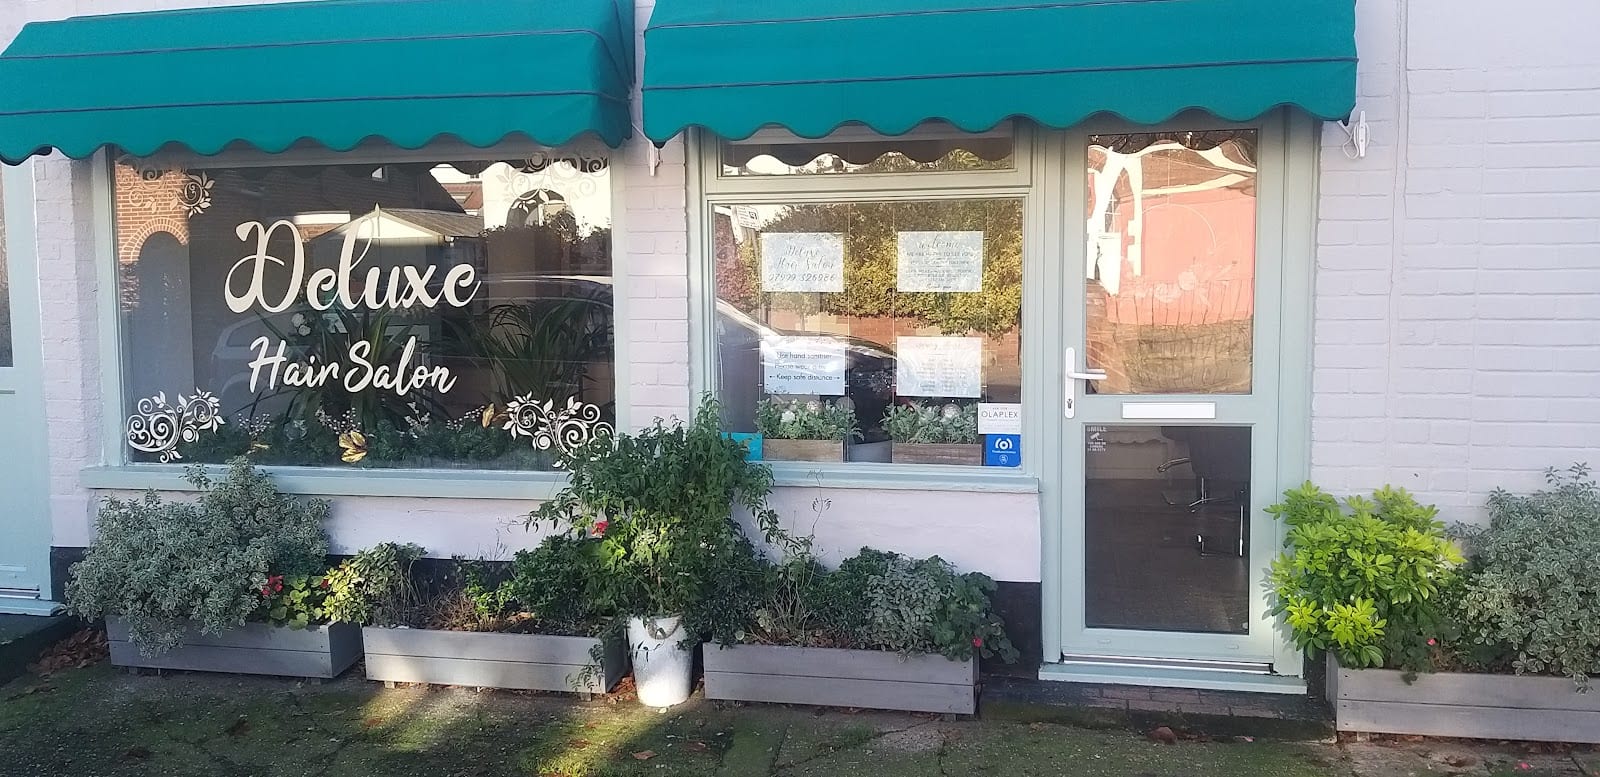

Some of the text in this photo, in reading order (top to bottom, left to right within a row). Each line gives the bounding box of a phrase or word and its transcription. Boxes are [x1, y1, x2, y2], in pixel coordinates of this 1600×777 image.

[224, 216, 481, 313] Deluxe
[248, 336, 457, 395] Hair Salon
[789, 351, 806, 359] hand
[776, 372, 833, 382] Keep safe distance
